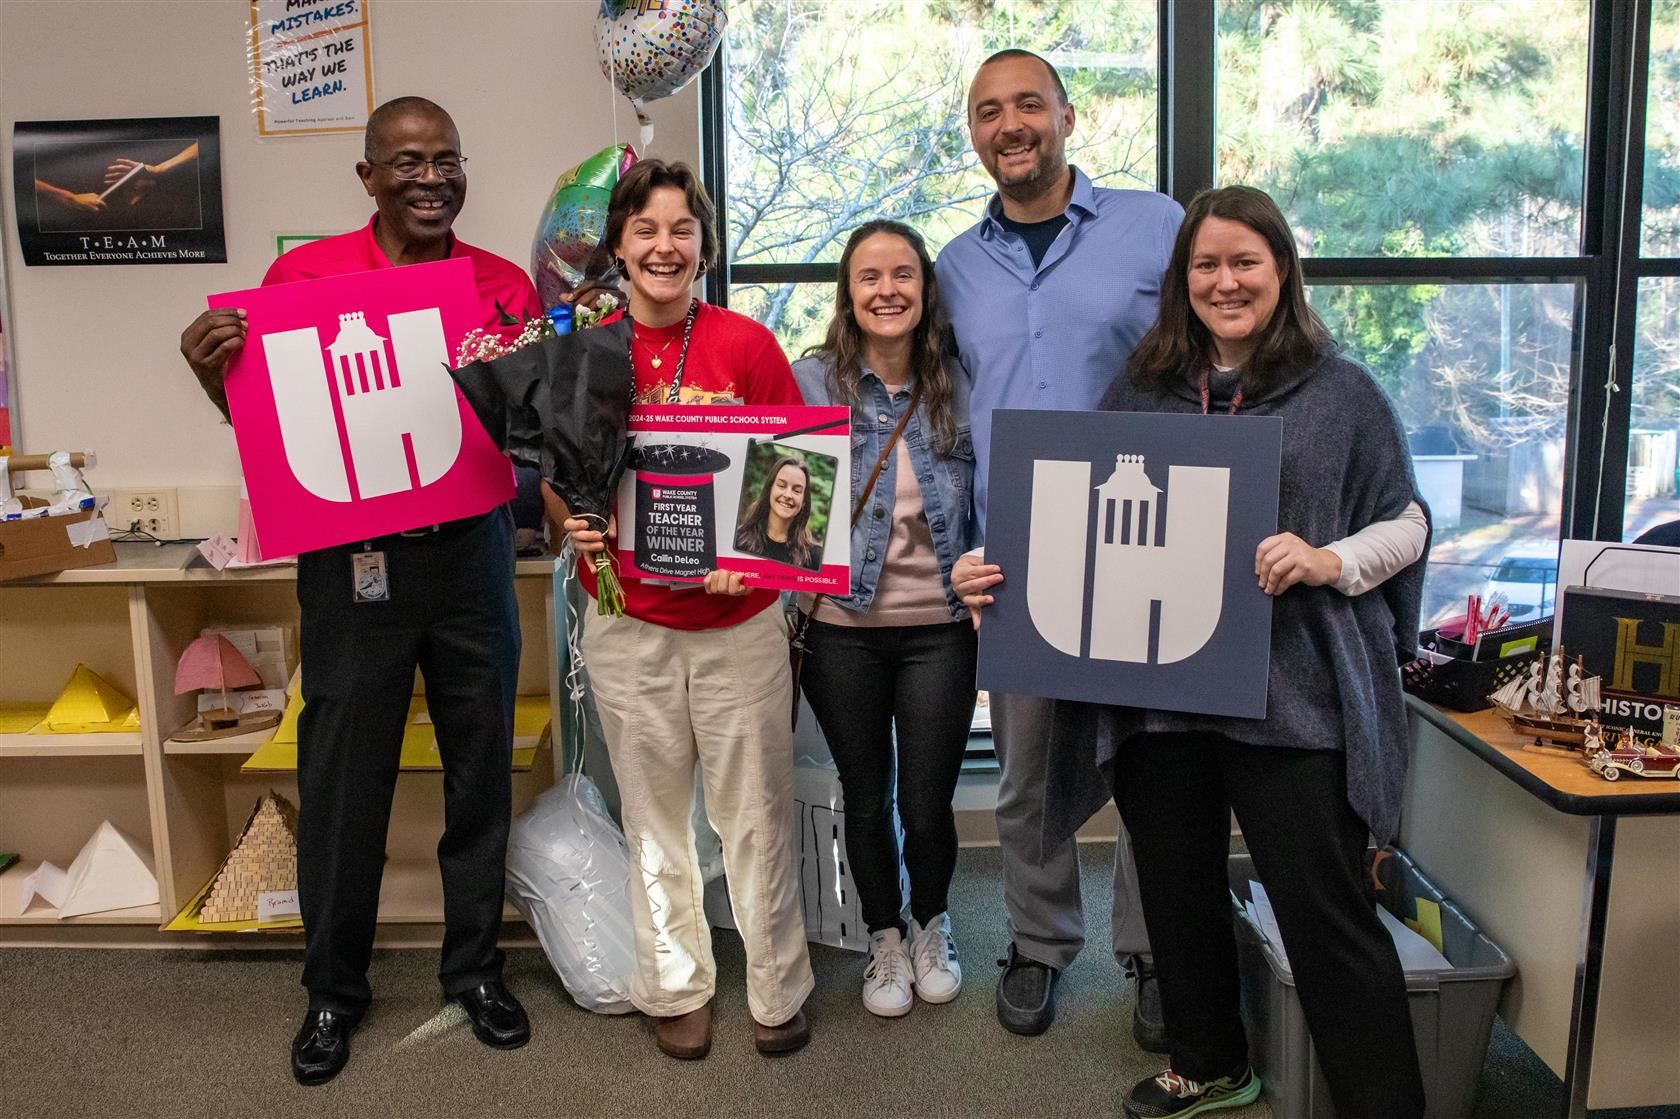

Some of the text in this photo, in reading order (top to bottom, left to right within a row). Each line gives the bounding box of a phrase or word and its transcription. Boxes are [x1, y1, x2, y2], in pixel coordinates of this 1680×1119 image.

[271, 0, 359, 35] MISTAKES.
[263, 38, 355, 74] THAT'S THE
[282, 59, 348, 88] WAY WE
[291, 79, 347, 105] LEARN.
[628, 414, 788, 425] 2024-25 WAKE COUNTY PUBLIC SCHOOL SYSTEM
[653, 502, 697, 513] FIRST YEAR
[647, 512, 702, 526] TEACHER
[646, 525, 705, 538] OF THE YEAR
[646, 535, 705, 552] WINNER
[674, 555, 700, 565] DeLeo
[659, 566, 674, 575] Drive
[674, 568, 697, 577] Magnet
